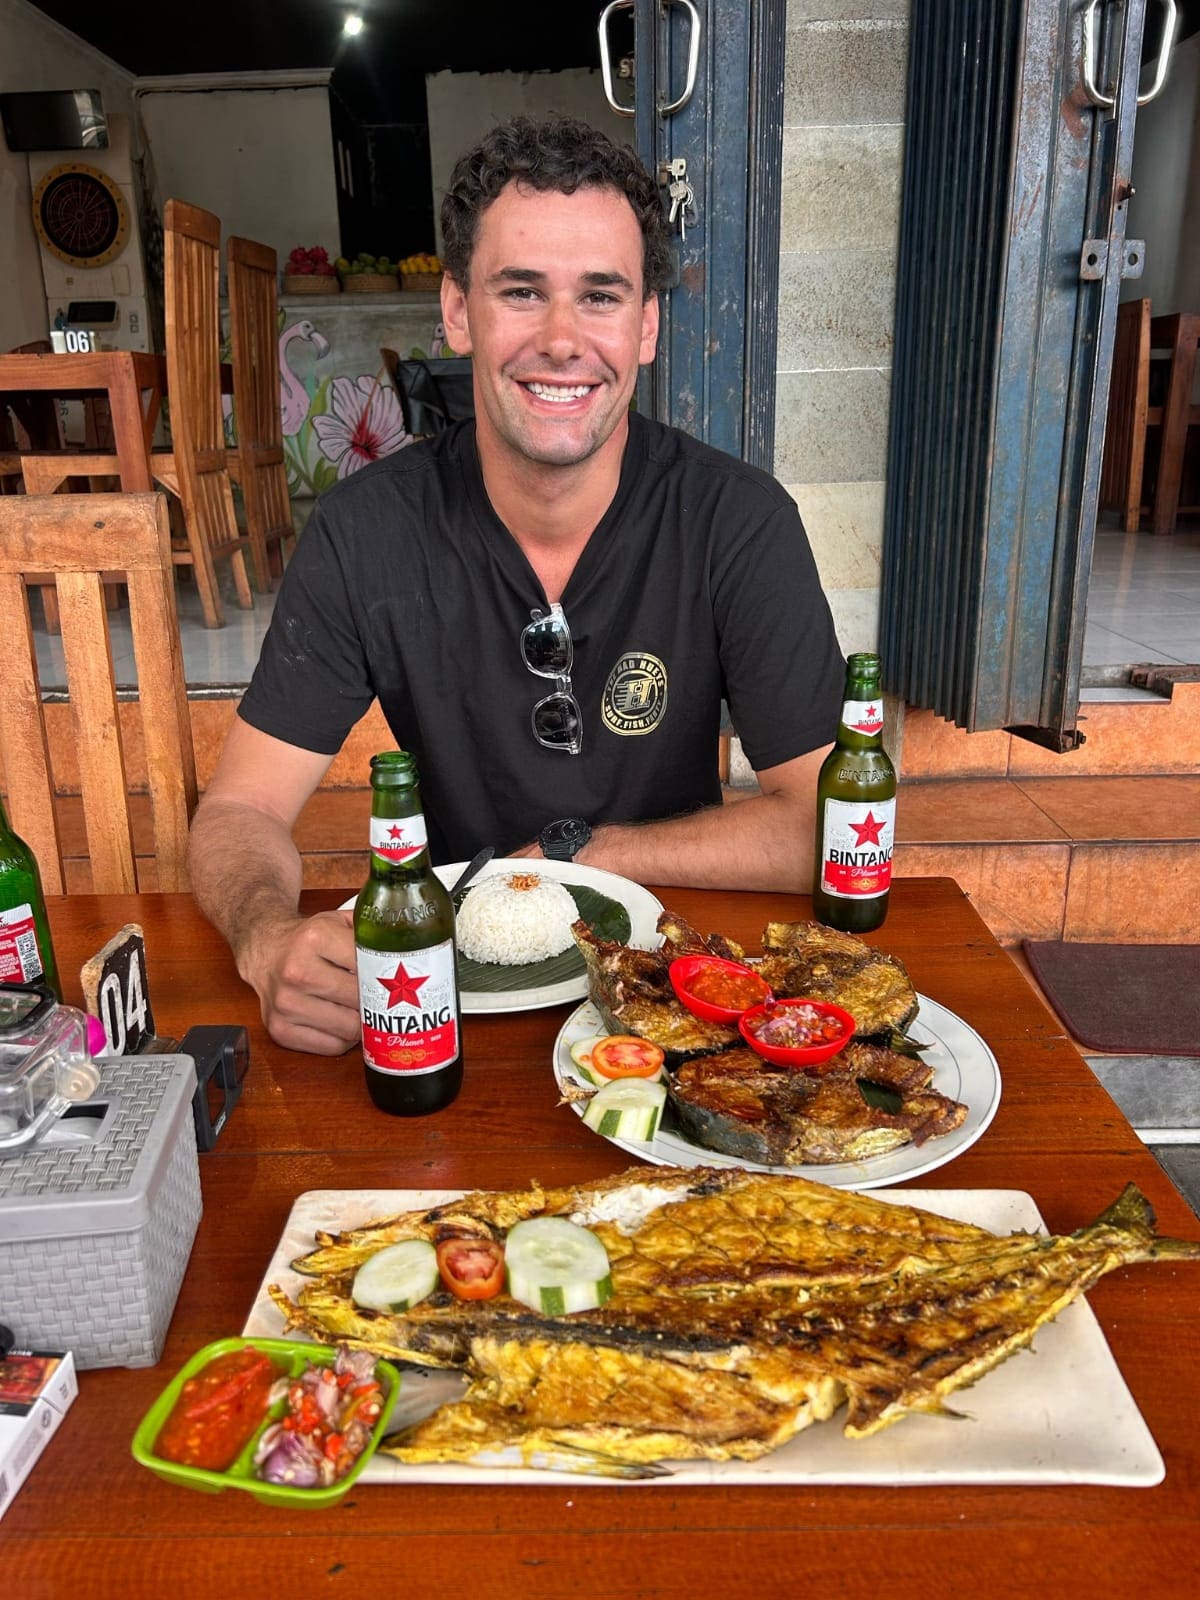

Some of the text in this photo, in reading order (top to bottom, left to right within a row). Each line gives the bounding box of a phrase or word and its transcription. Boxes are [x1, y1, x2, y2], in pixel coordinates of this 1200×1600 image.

[66, 331, 90, 353] 06
[639, 659, 664, 687] HUEYS
[380, 841, 414, 849] BINTANG
[101, 949, 148, 1056] 04
[363, 1006, 451, 1034] BINTANG
